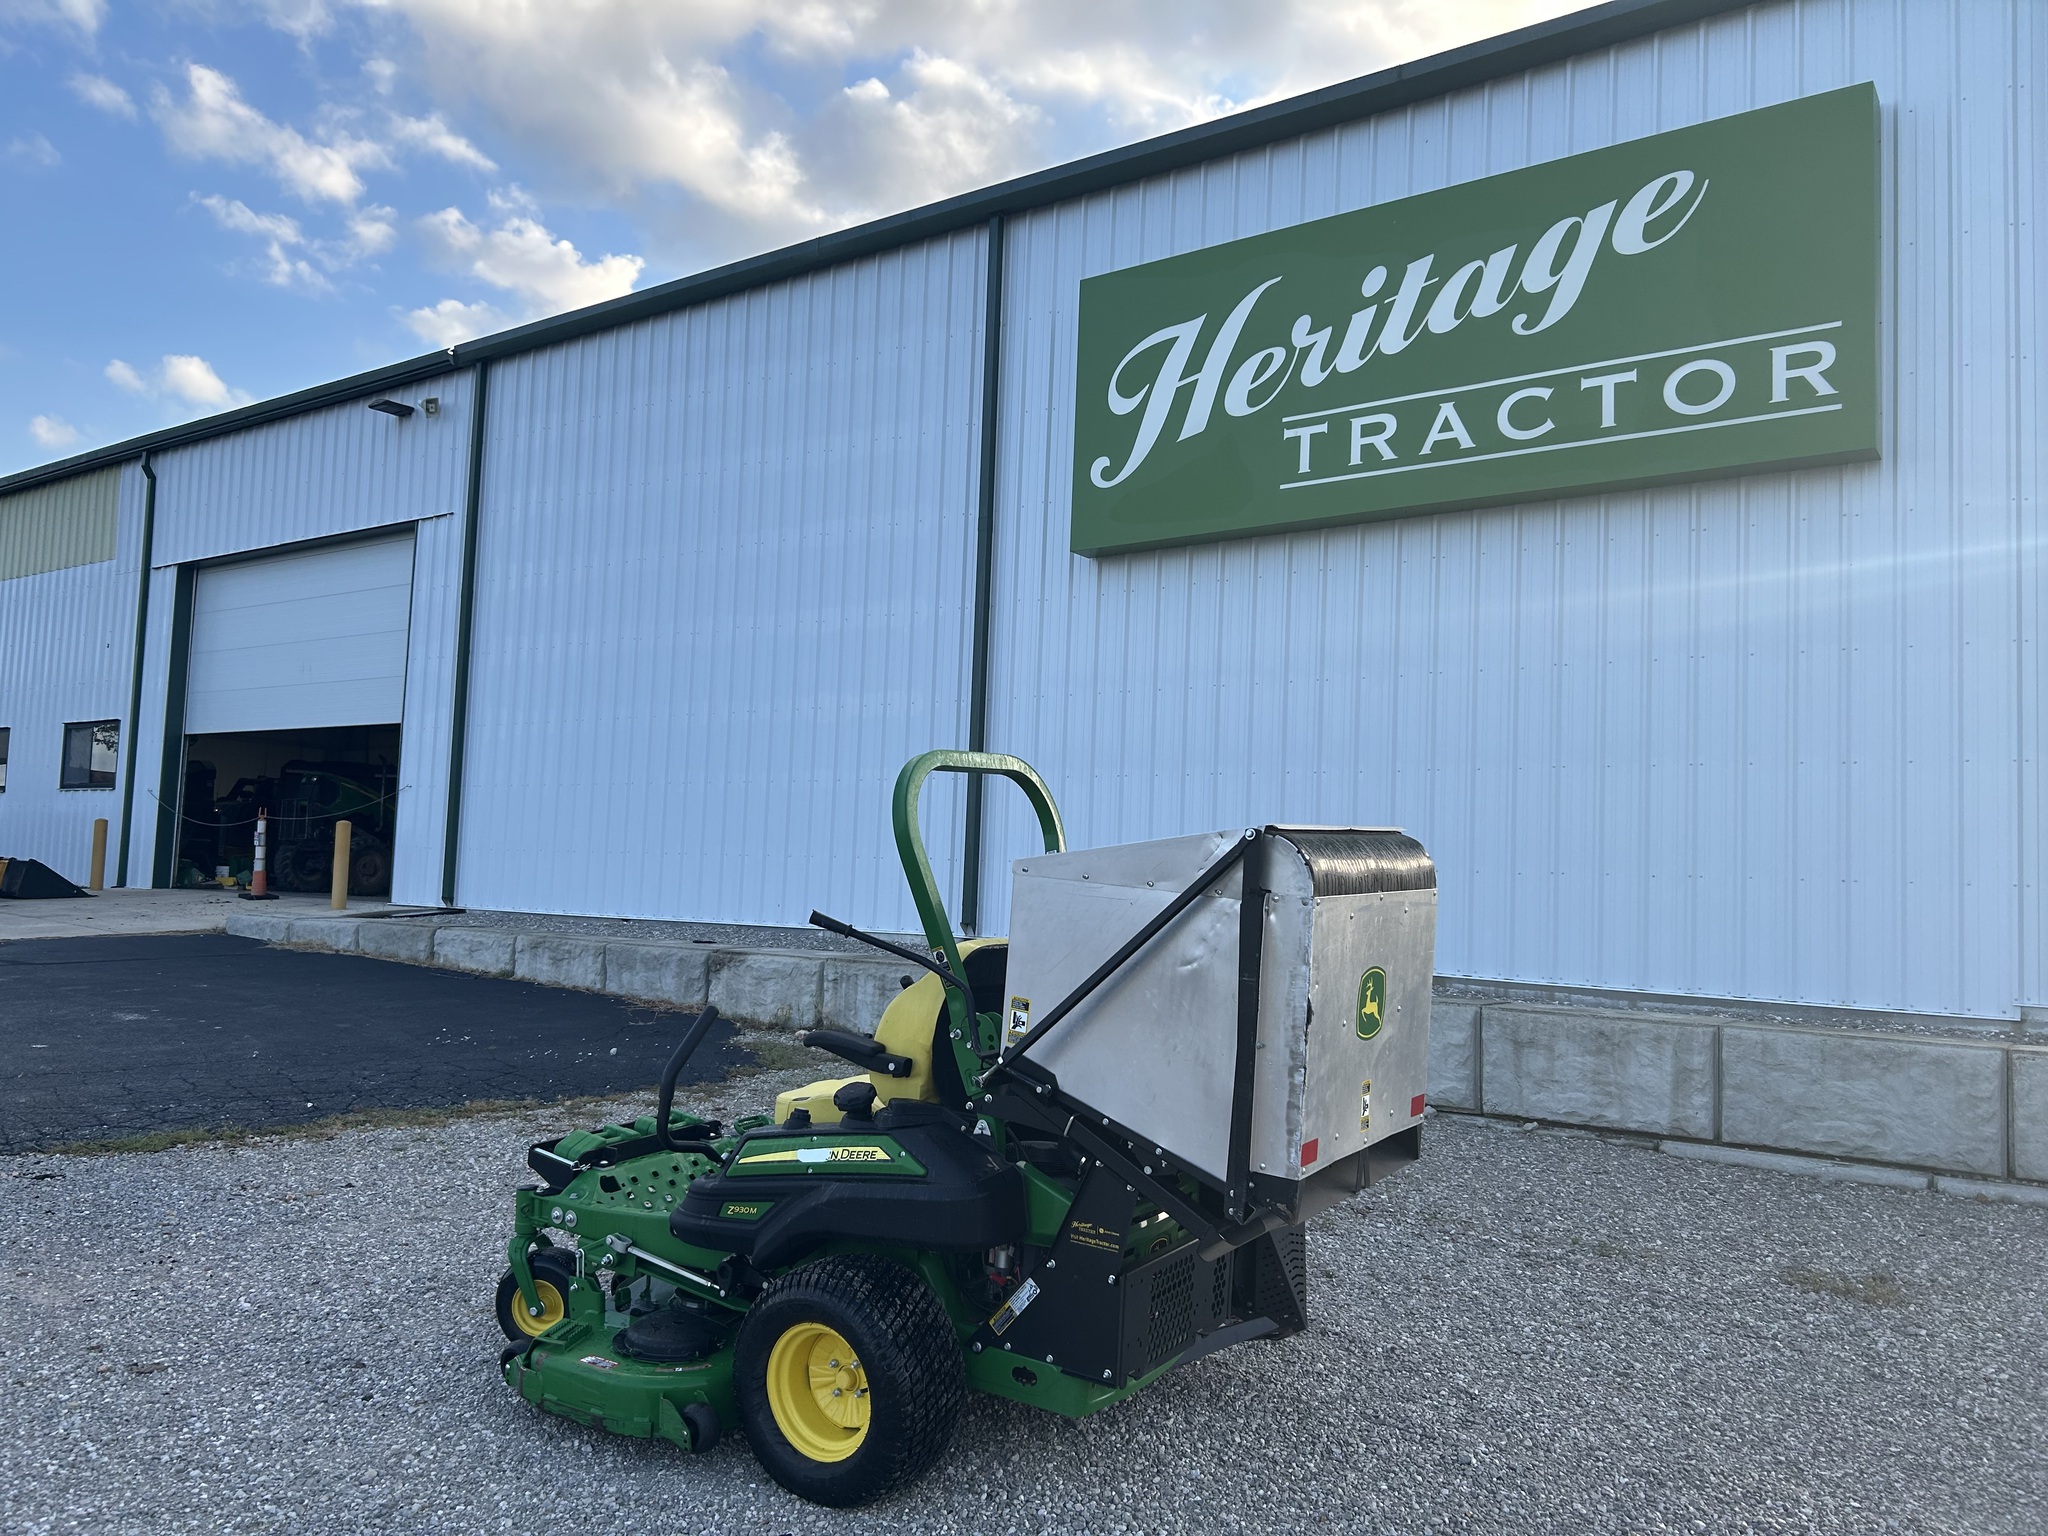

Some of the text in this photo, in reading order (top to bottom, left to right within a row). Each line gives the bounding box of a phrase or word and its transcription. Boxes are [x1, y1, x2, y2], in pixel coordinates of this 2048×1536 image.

[1090, 169, 1709, 489] Heritage
[1282, 340, 1839, 474] TRACTOR
[841, 1148, 878, 1160] DEERE
[727, 1205, 757, 1215] Z930M
